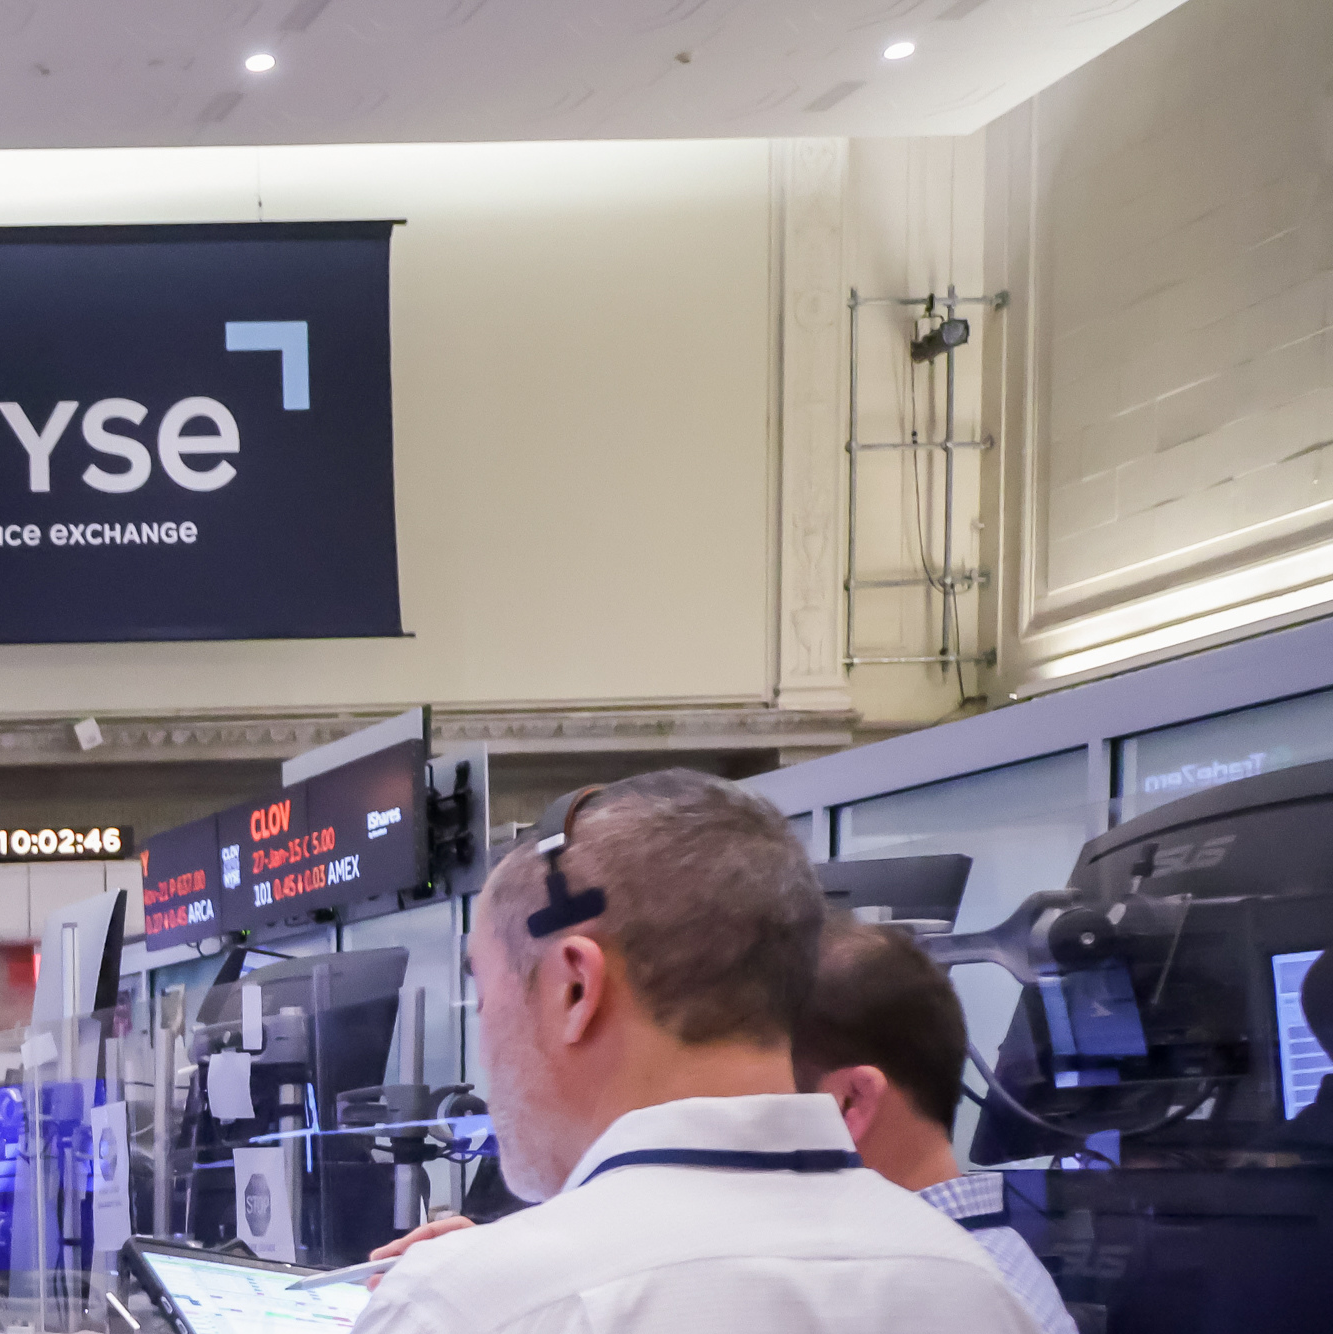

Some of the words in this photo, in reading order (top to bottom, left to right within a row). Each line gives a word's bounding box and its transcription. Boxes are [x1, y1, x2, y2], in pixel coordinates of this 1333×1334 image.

[250, 799, 292, 842] CLOV
[312, 826, 336, 855] 5.00
[253, 880, 273, 907] 101
[303, 863, 326, 893] 0.03
[327, 854, 361, 886] AMEX
[188, 898, 215, 924] ARCA
[246, 1195, 270, 1214] STOP
